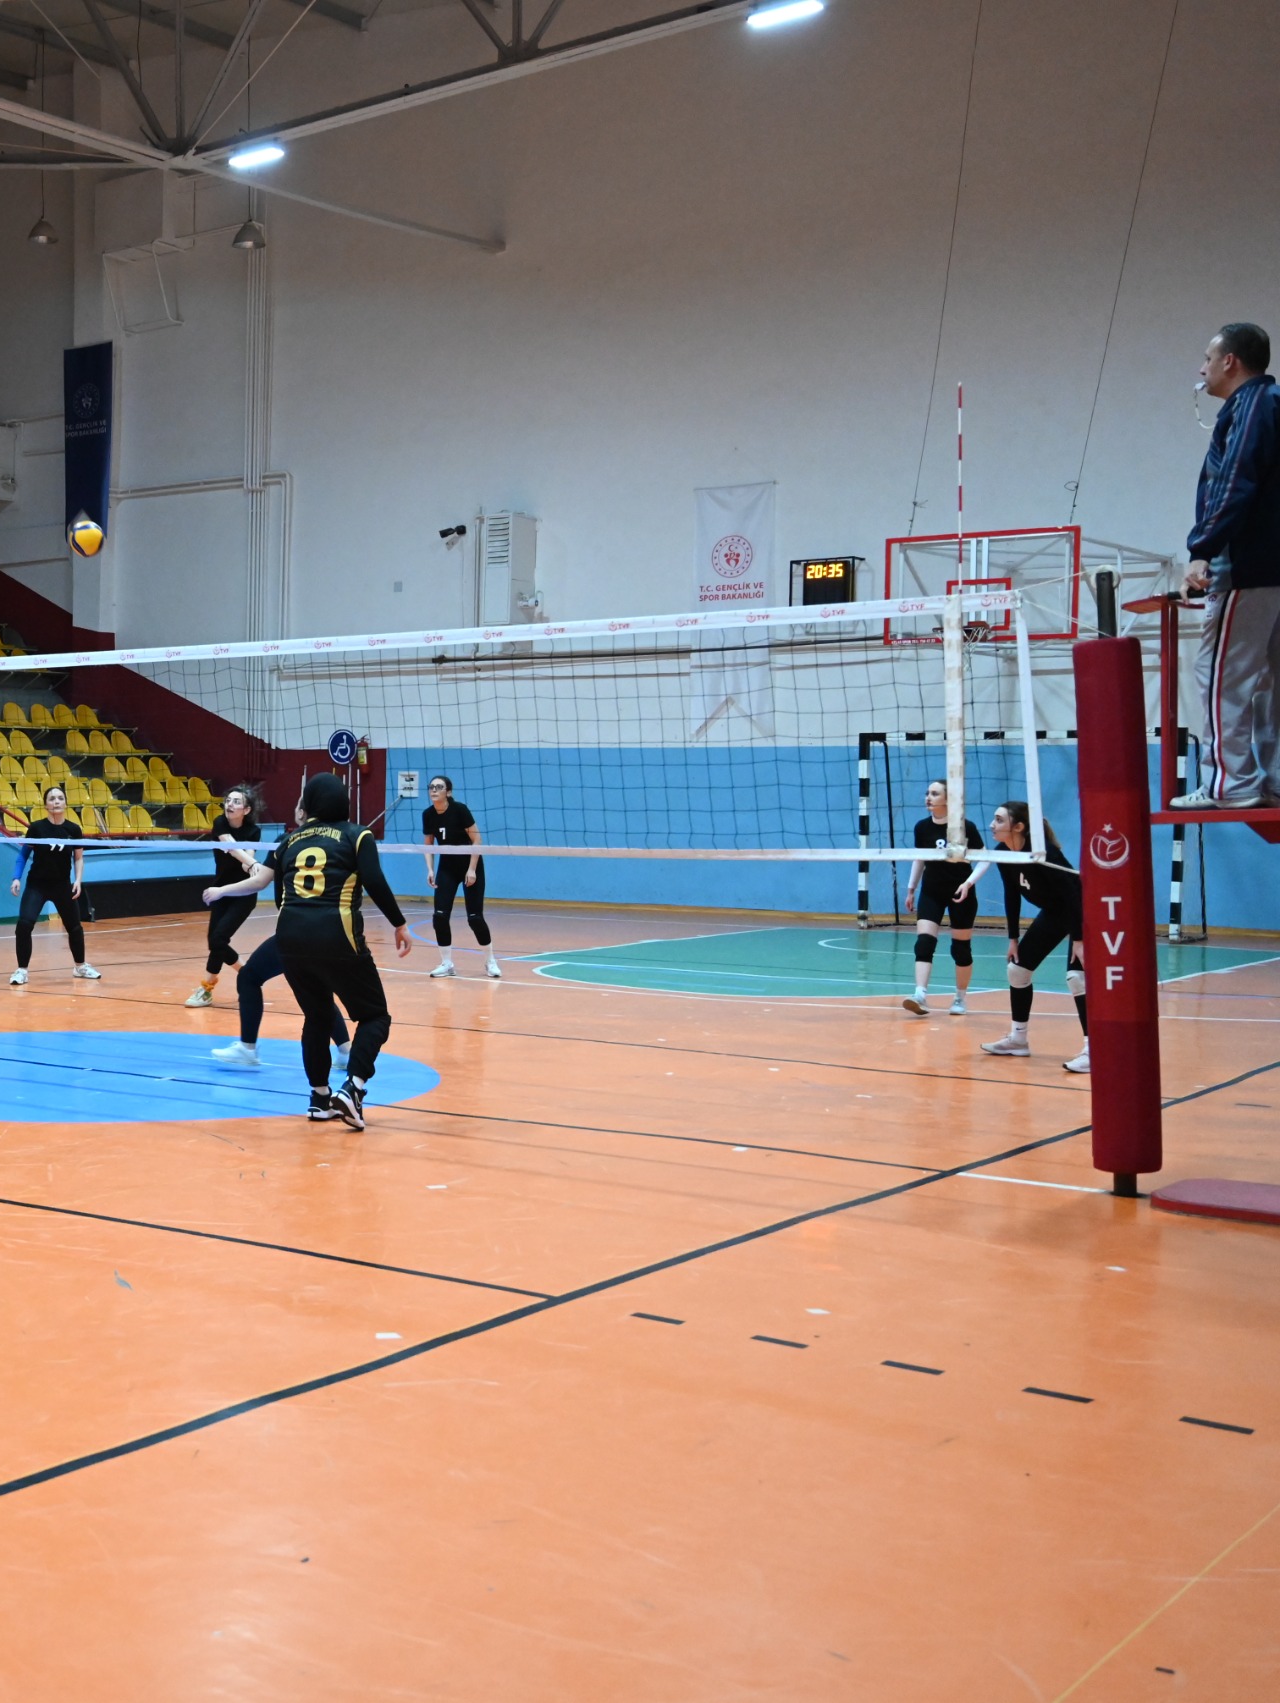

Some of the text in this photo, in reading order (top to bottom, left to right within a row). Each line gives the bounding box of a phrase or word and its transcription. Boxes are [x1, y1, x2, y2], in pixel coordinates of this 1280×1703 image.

[806, 563, 844, 579] 20:35
[699, 585, 714, 593] T.C.
[715, 583, 751, 593] GENÇLİK
[699, 590, 764, 602] SPOR BAKANLIĞI
[439, 827, 446, 840] 7
[293, 846, 327, 899] 8
[1020, 872, 1031, 891] 4
[1100, 896, 1125, 991] TVF
